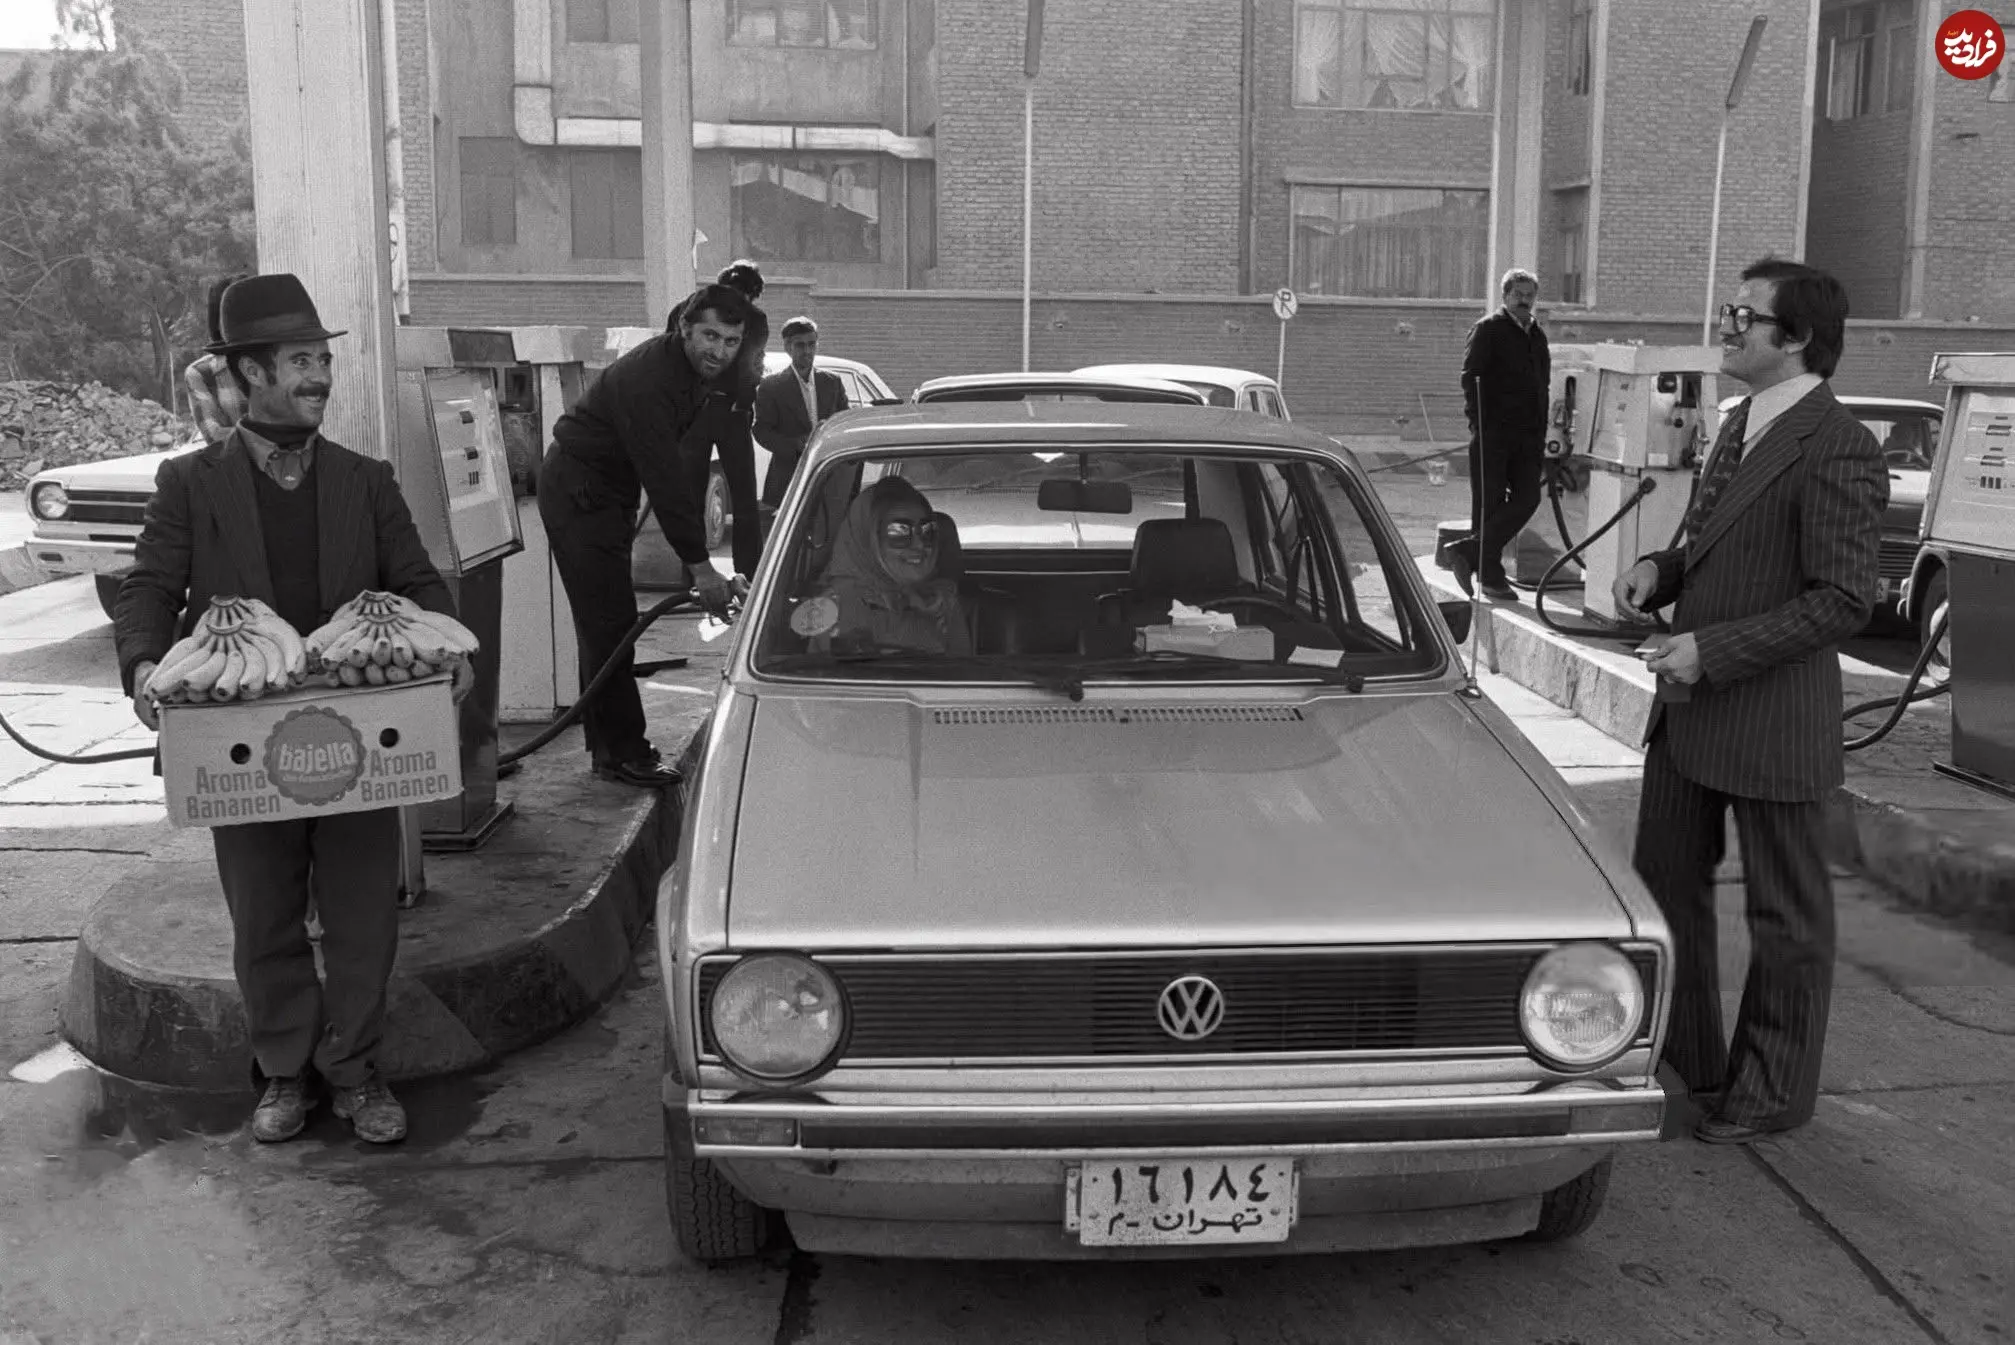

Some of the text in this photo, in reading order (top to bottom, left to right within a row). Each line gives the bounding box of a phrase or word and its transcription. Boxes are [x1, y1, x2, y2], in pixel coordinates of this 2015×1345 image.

[280, 742, 357, 775] bajella
[370, 750, 436, 777] Aroma
[196, 767, 266, 794] Aroma
[361, 774, 449, 801] Bananen
[187, 794, 281, 819] Bananen
[1161, 978, 1222, 1037] VW
